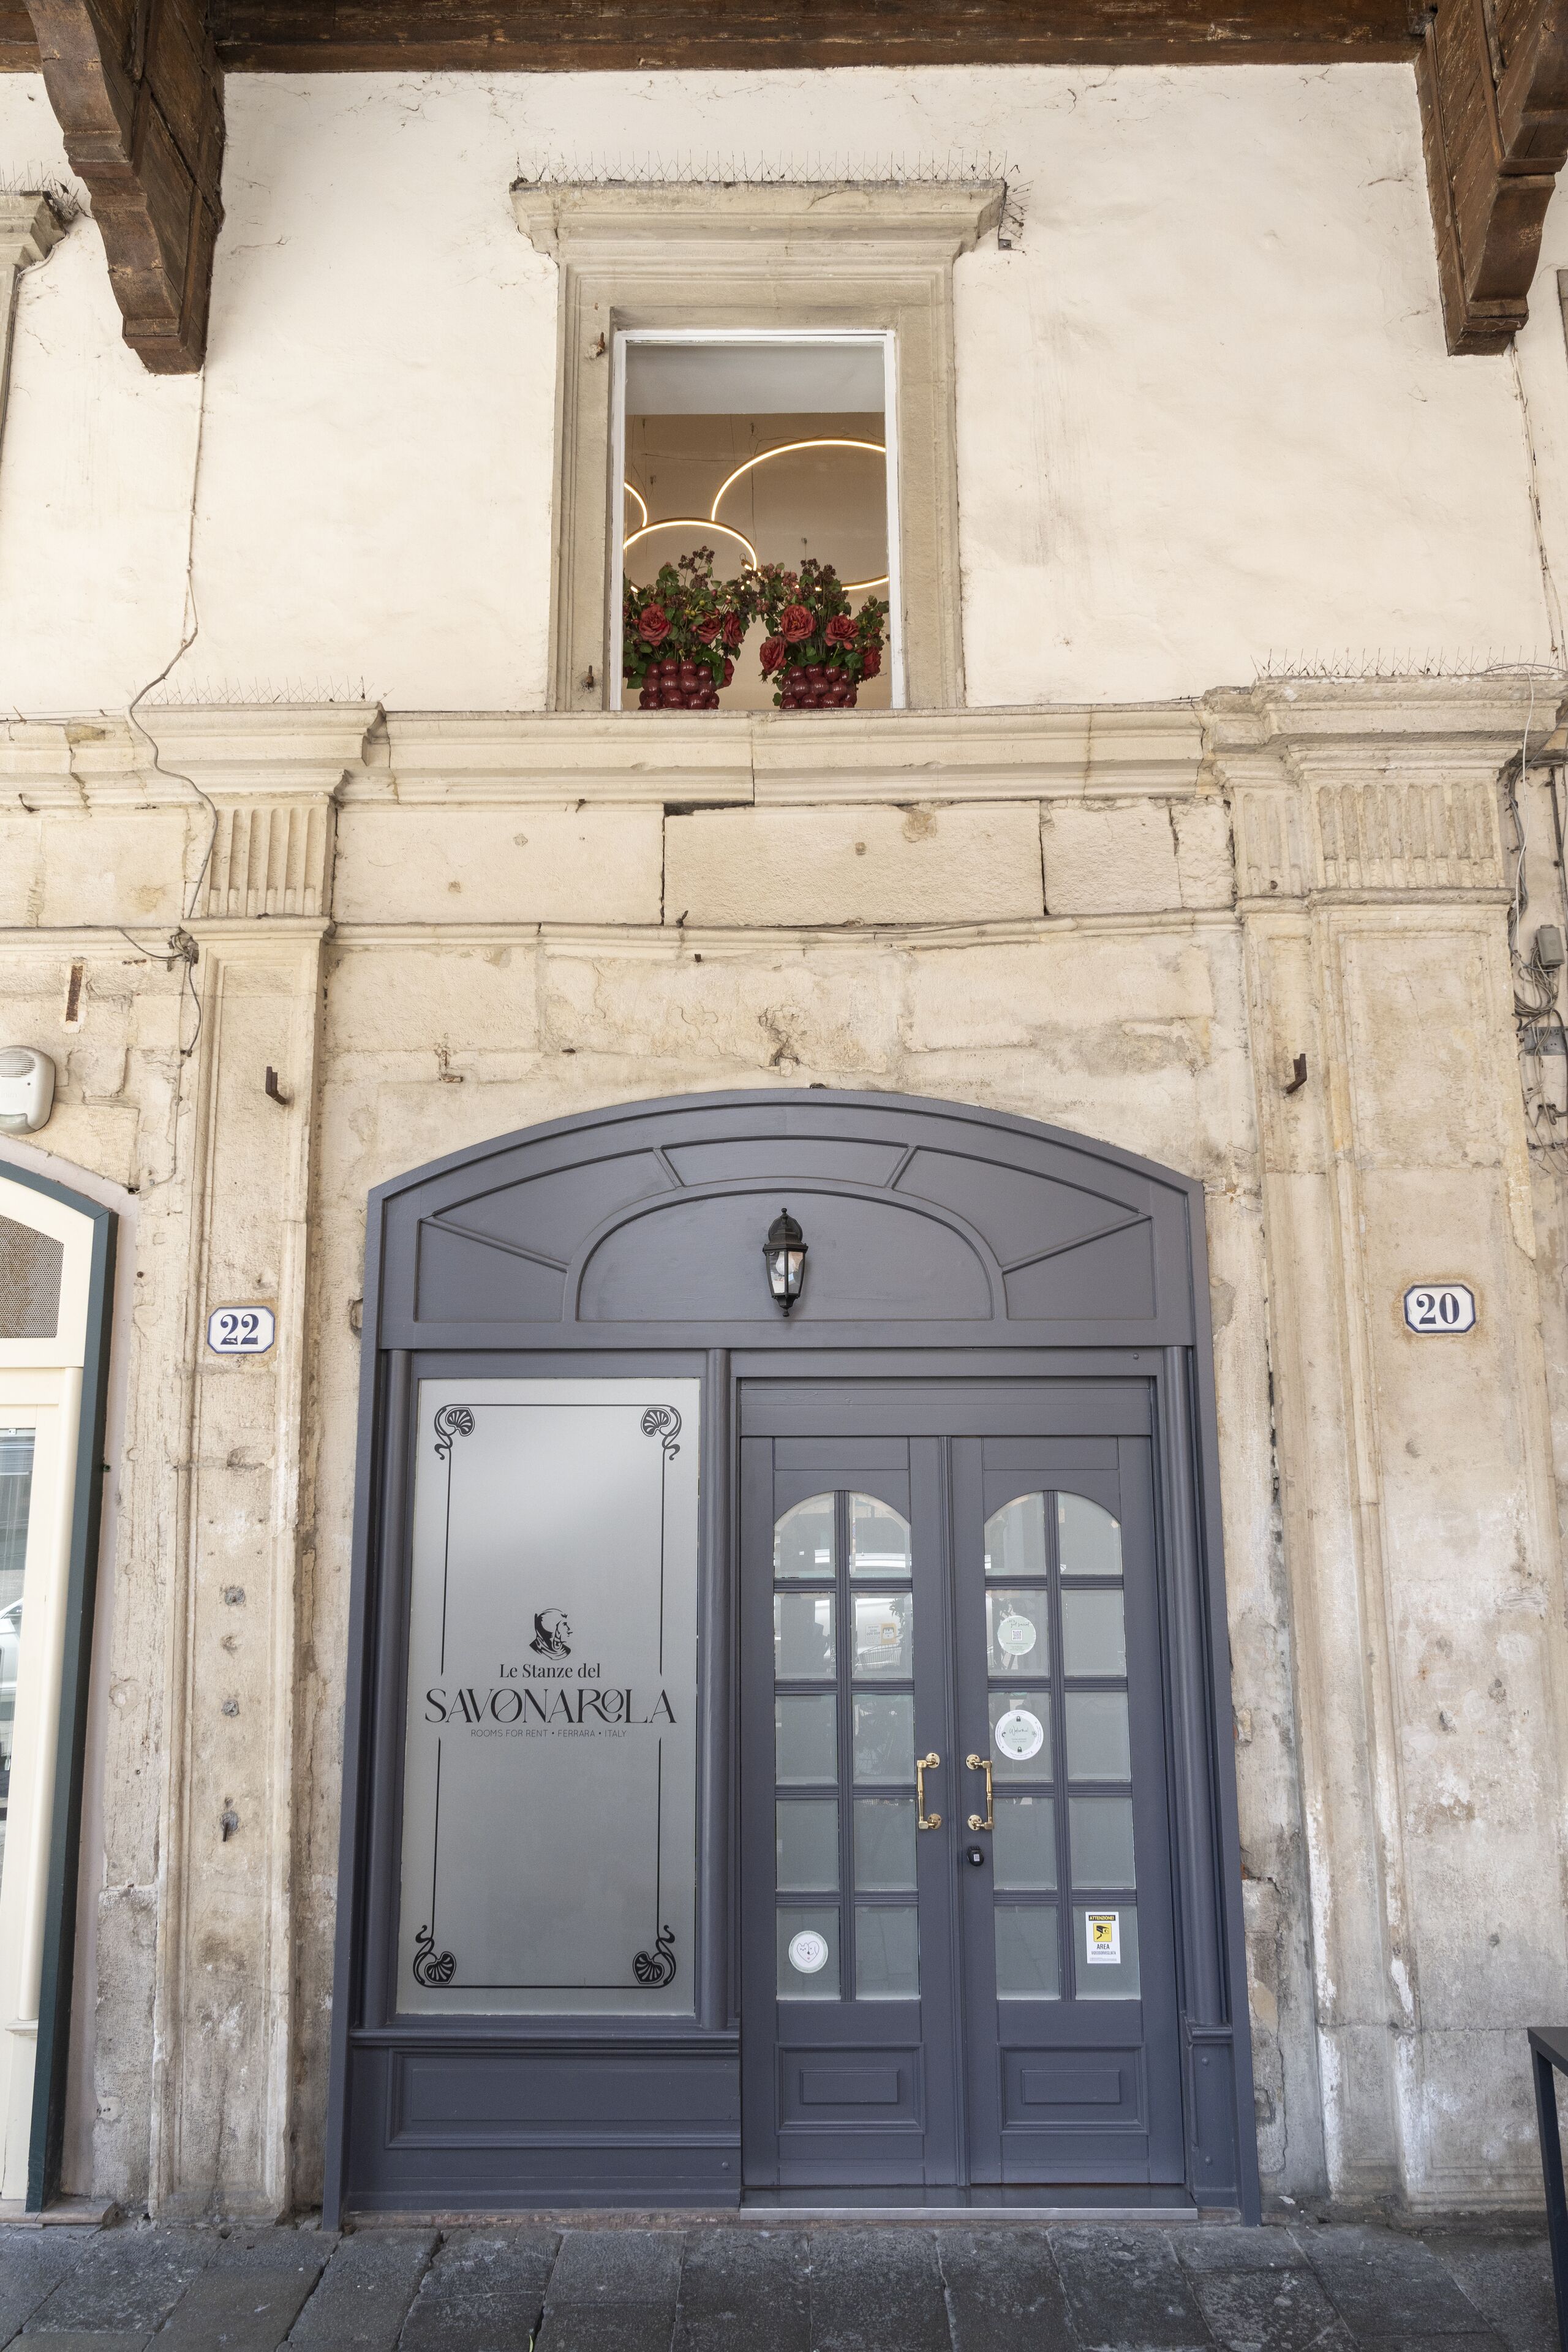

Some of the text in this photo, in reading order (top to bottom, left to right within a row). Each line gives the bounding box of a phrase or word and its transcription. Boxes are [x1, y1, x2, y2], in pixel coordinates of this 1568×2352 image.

[1416, 1293, 1460, 1324] 20
[221, 1314, 259, 1345] 22
[499, 1662, 601, 1678] Le Stanze del
[424, 1688, 677, 1724] SAVONAROLA
[470, 1729, 627, 1738] ROOMS FOR RENT FERRARA ITALY
